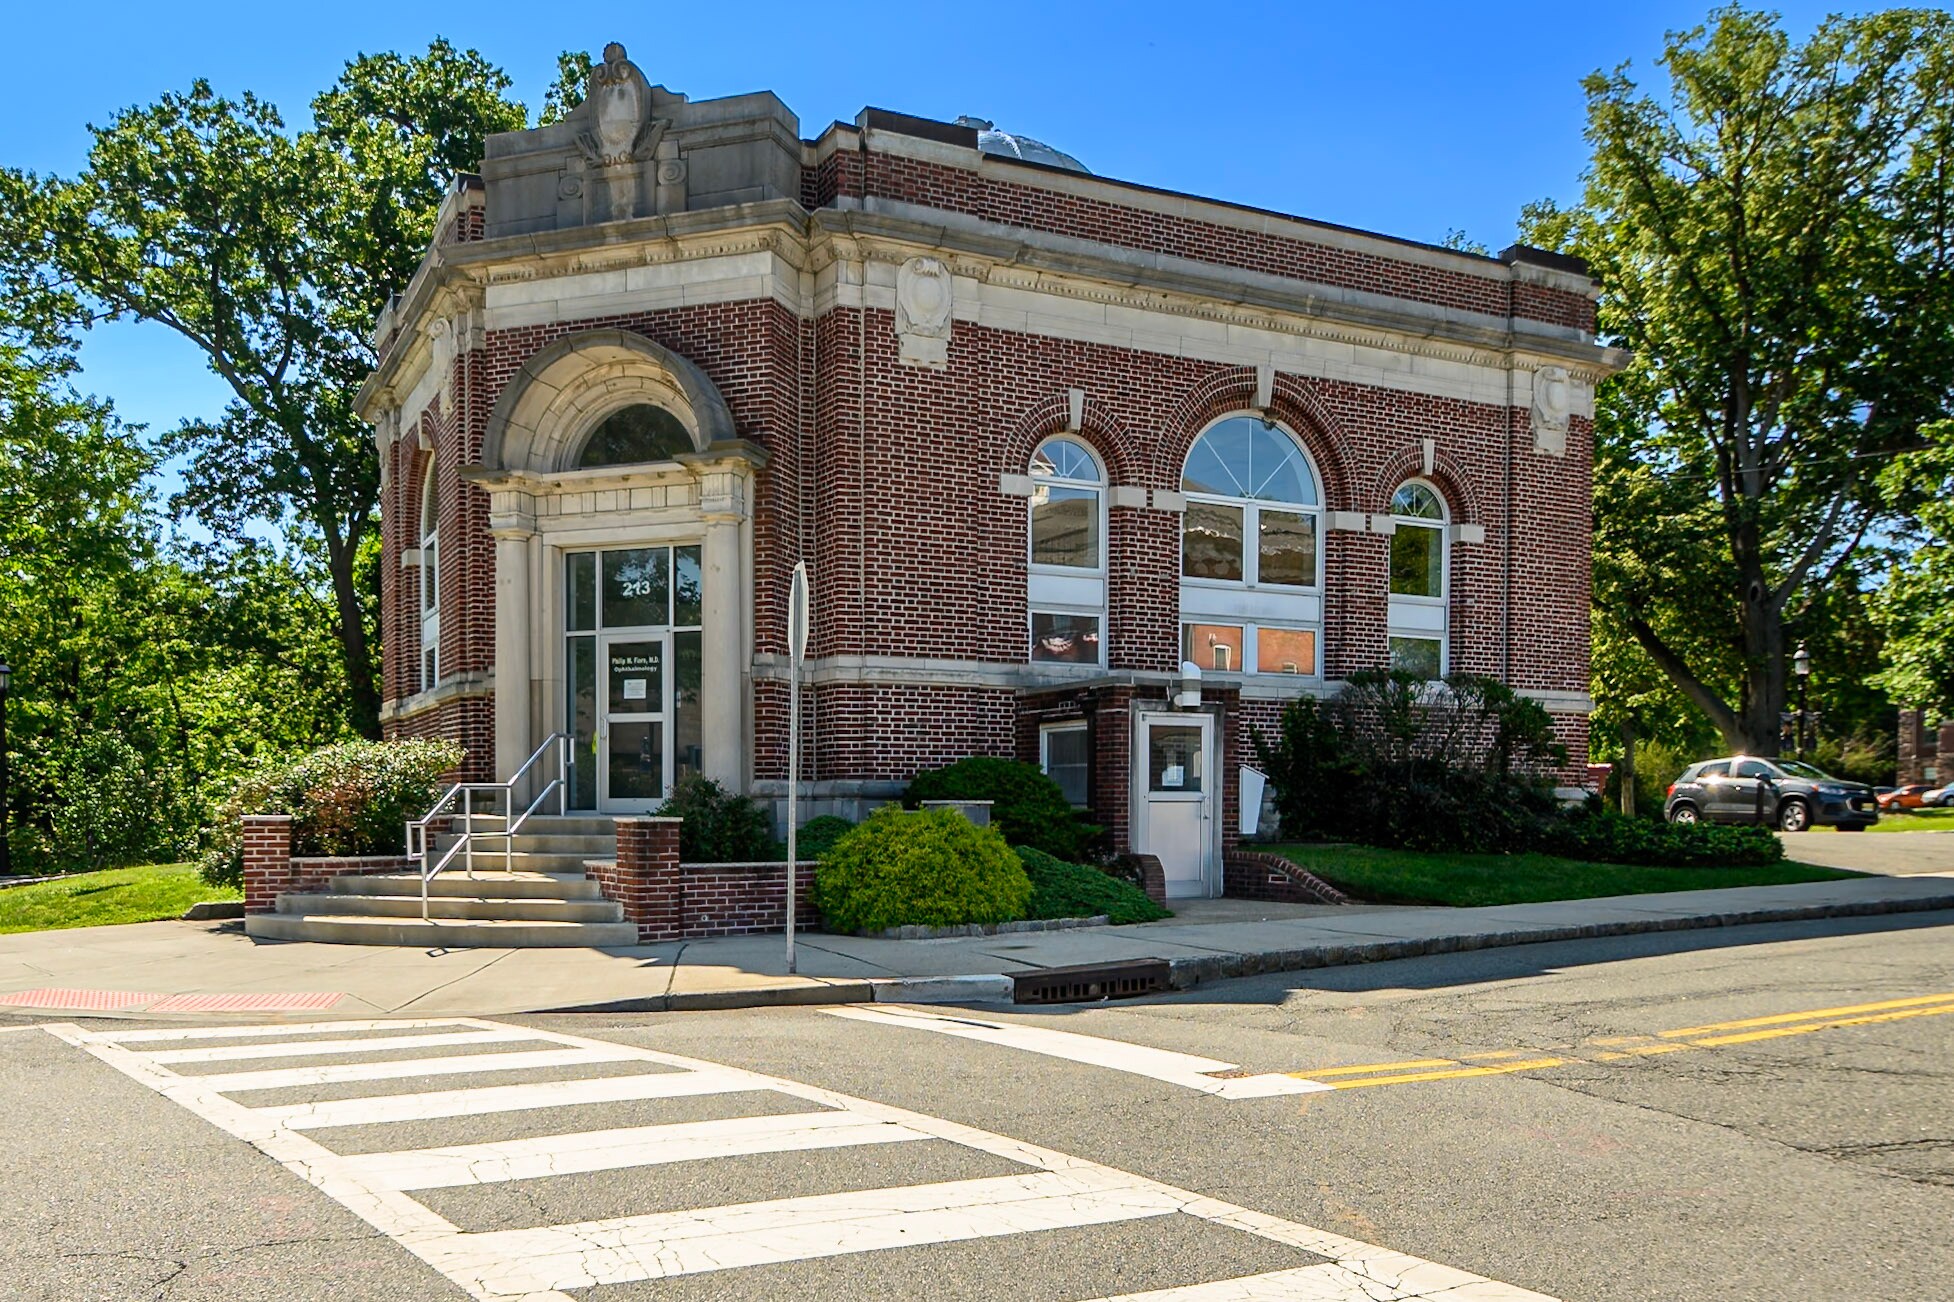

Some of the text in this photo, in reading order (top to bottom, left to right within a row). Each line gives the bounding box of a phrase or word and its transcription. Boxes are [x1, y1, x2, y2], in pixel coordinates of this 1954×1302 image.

[622, 581, 650, 597] 213
[612, 657, 626, 666] Philip
[649, 655, 660, 664] M.D.
[614, 665, 657, 673] Ophthalmology
